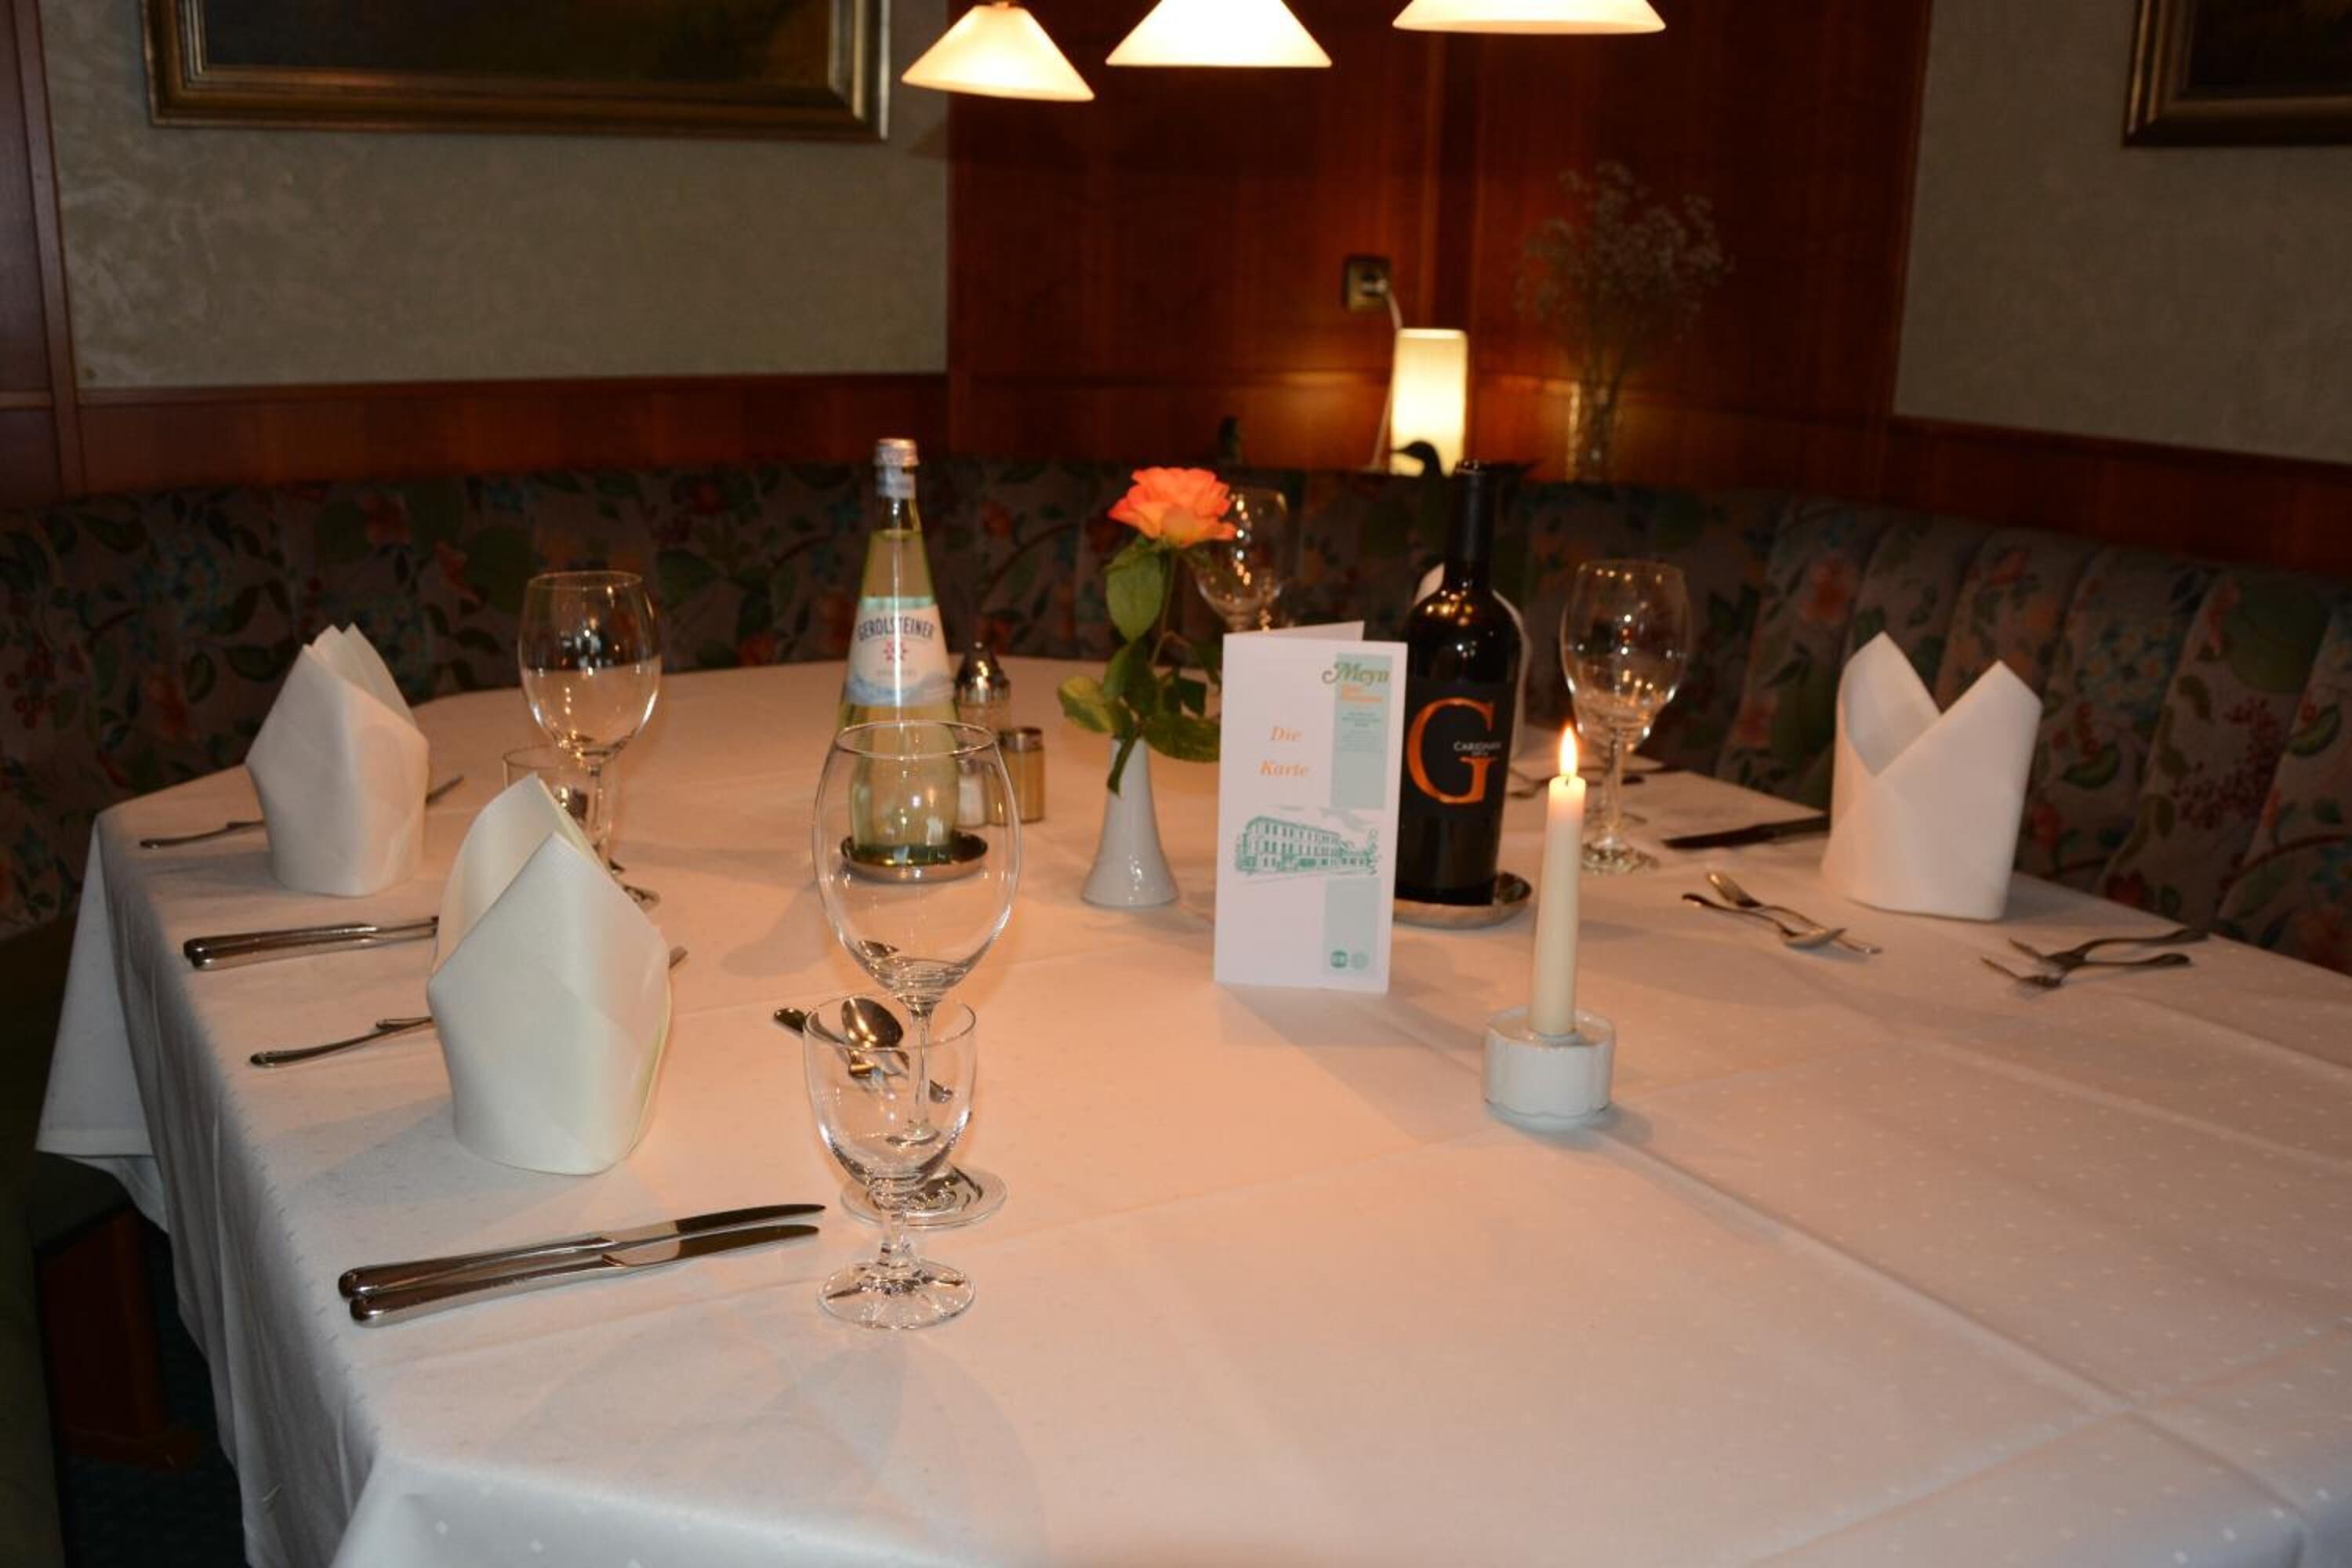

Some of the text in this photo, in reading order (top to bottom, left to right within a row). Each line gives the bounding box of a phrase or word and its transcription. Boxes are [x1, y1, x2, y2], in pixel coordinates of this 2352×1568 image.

[1270, 726, 1302, 742] Die
[1406, 696, 1496, 804] G
[1259, 758, 1310, 778] Karte
